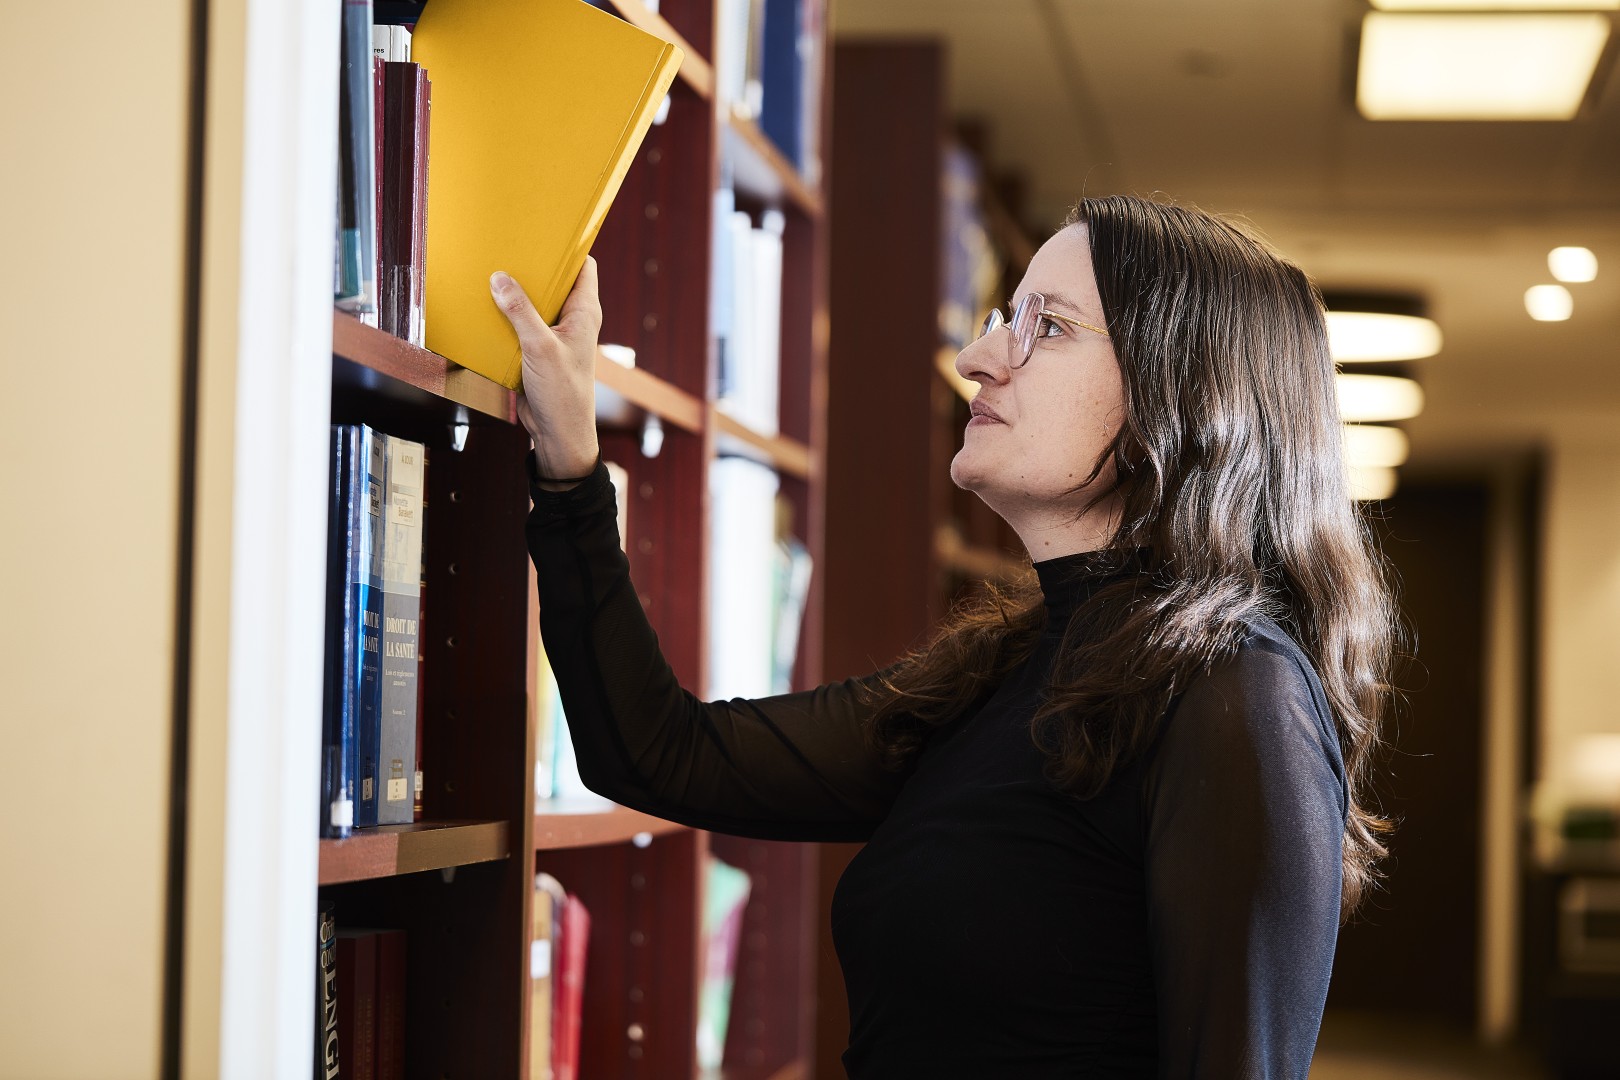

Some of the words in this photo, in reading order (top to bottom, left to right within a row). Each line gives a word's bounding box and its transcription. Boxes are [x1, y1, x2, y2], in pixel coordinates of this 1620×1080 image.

[386, 617, 406, 634] DROIT
[407, 619, 417, 635] DE
[386, 641, 395, 656] LA
[395, 639, 415, 658] SANTÉ
